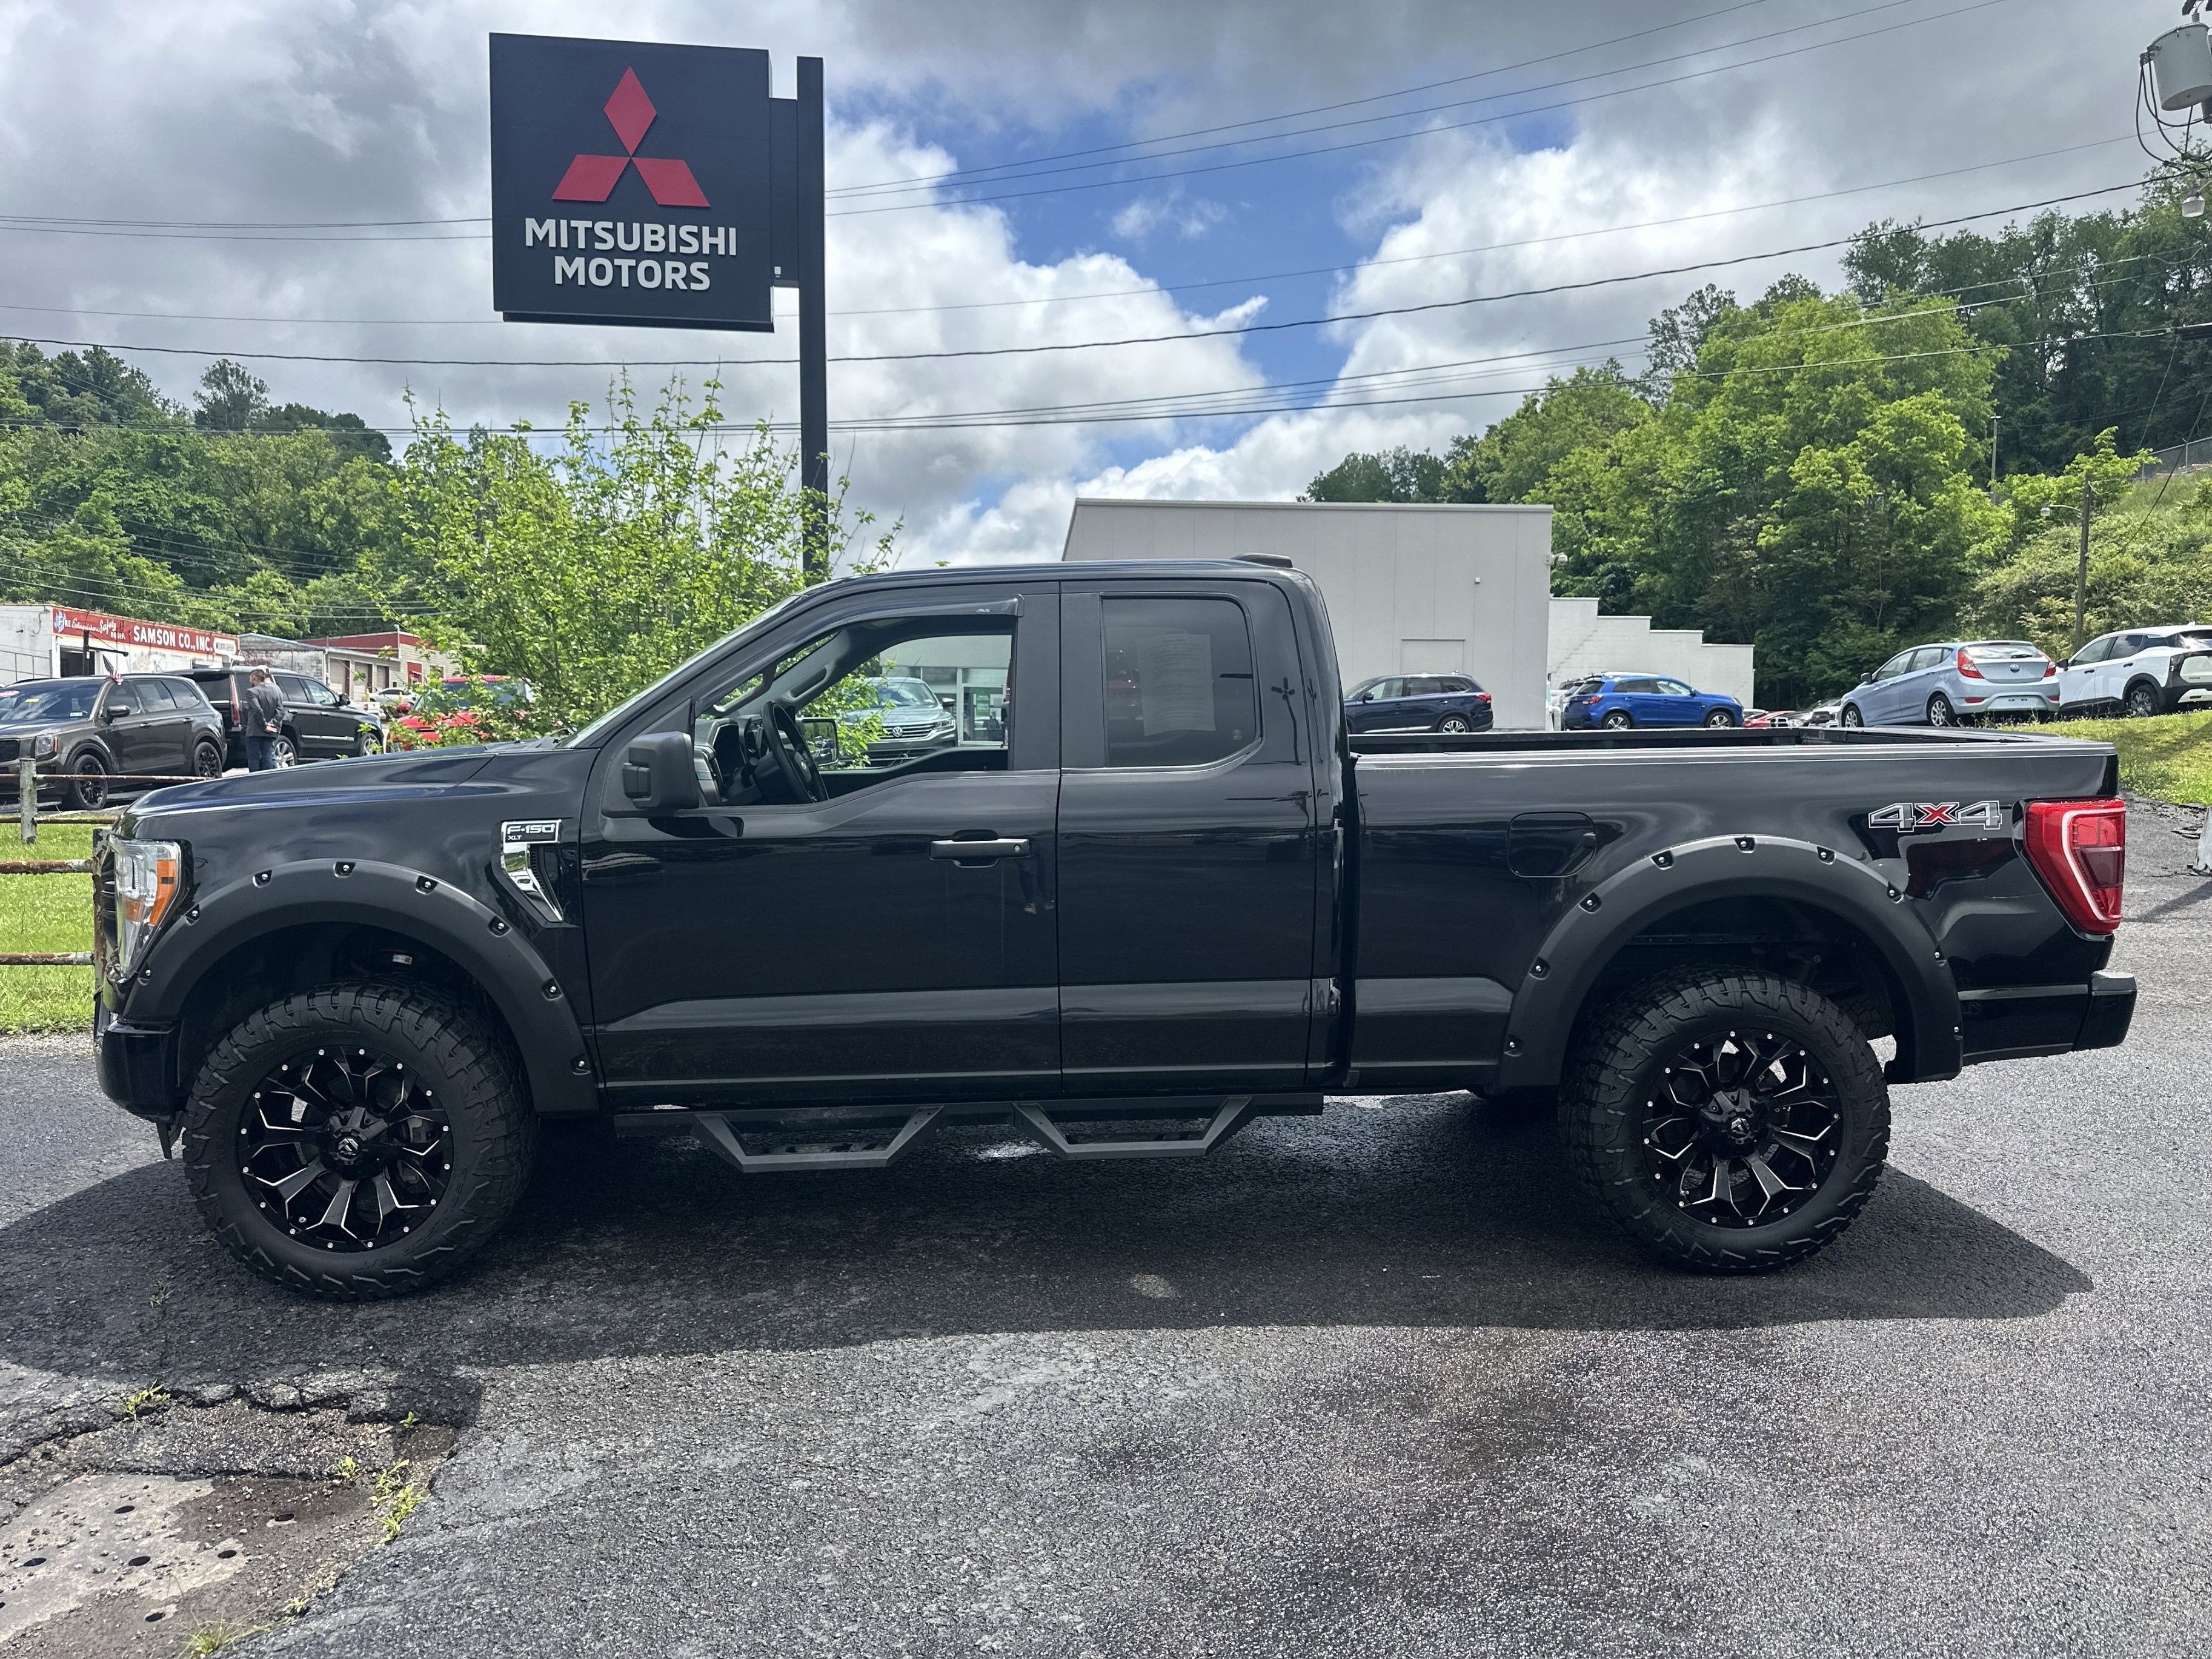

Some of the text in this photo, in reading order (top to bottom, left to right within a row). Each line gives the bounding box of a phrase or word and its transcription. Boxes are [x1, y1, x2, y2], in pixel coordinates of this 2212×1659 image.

[525, 218, 737, 256] MITSUBISHI
[554, 255, 711, 291] MOTORS
[99, 619, 117, 634] Safety
[133, 625, 176, 647] SAMSON
[507, 824, 556, 834] F-150
